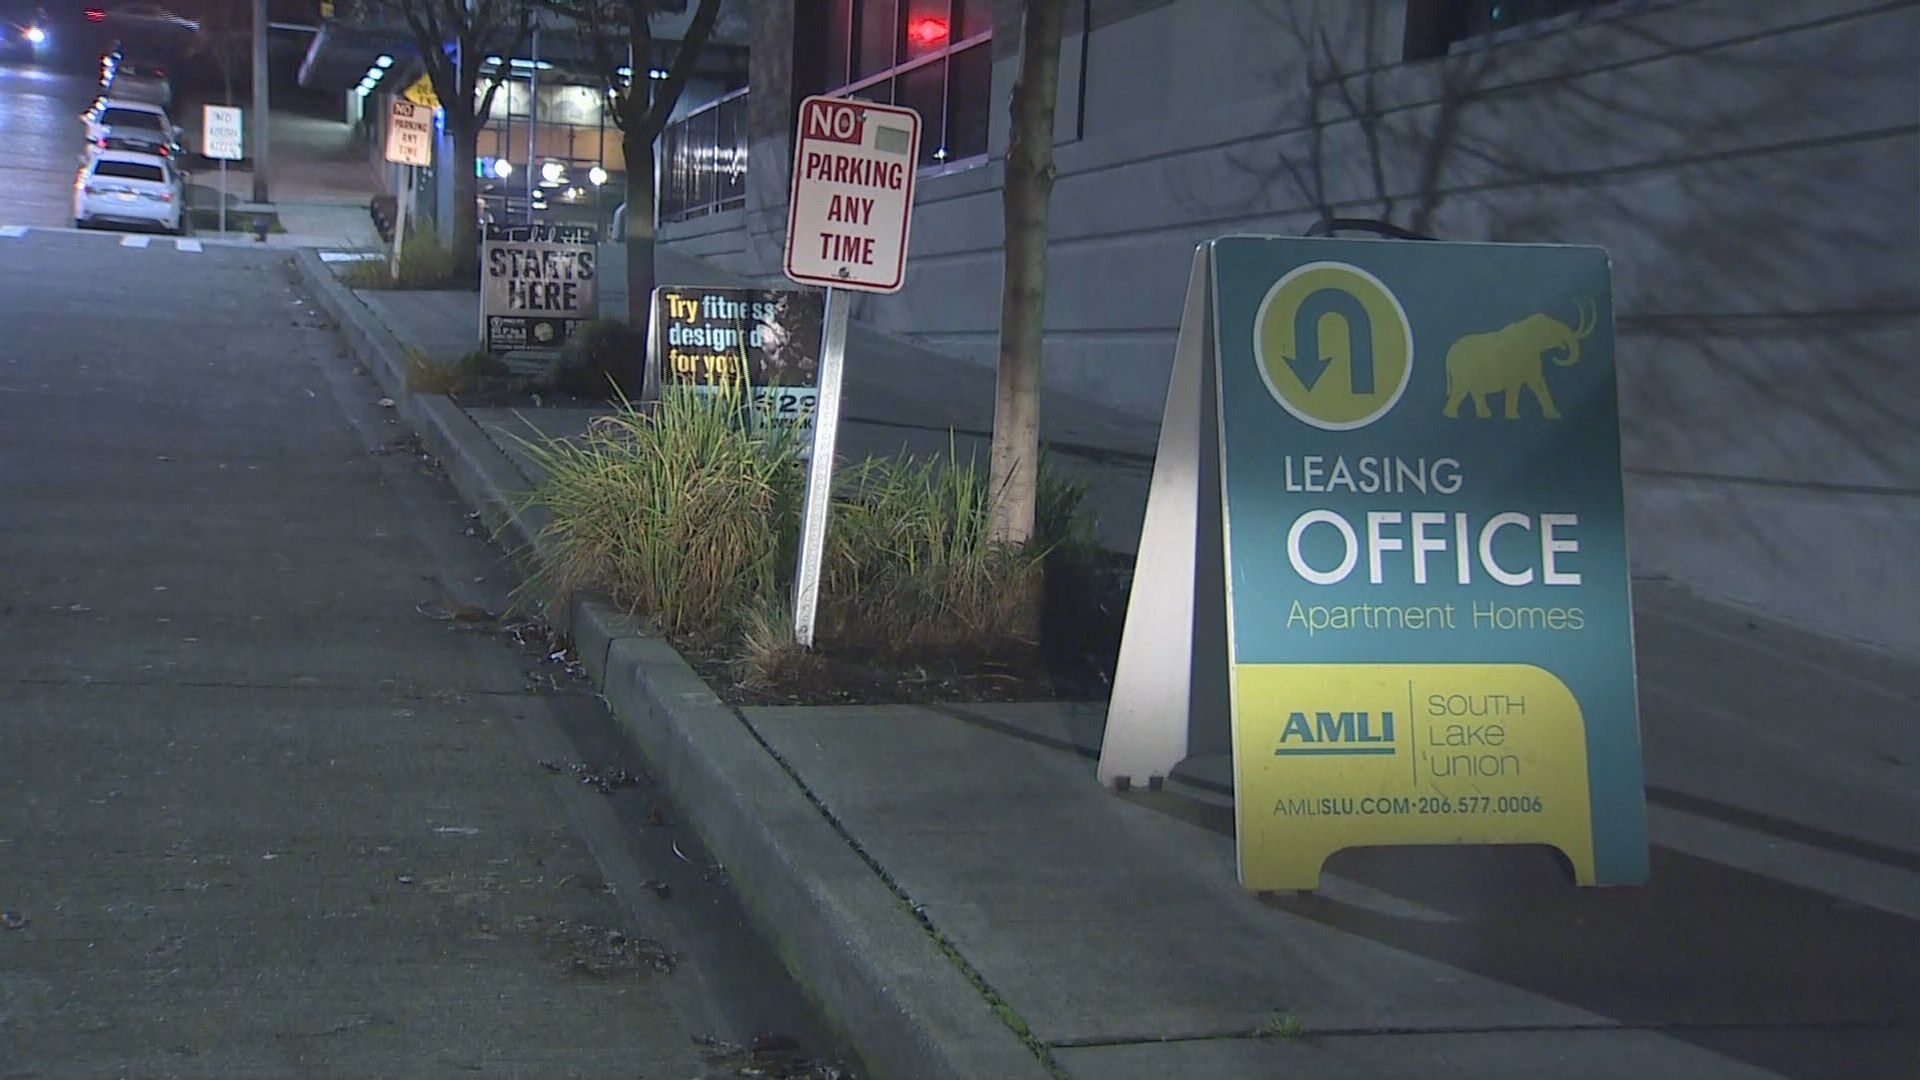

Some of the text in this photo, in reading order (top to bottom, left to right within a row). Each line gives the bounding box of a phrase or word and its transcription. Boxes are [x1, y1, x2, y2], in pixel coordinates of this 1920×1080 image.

[213, 111, 232, 123] NO
[394, 103, 413, 116] NO
[809, 103, 856, 140] NO
[395, 119, 428, 133] PARKING
[402, 132, 418, 144] ANY
[399, 144, 418, 157] TIME
[806, 152, 903, 190] PARKING
[827, 194, 875, 226] ANY
[489, 248, 594, 280] STARTS
[820, 233, 875, 265] TIME
[508, 280, 578, 311] HERE
[666, 294, 698, 323] Try
[669, 349, 699, 373] for
[1284, 455, 1463, 494] LEASING
[1286, 509, 1582, 586] OFFICE
[1285, 600, 1584, 636] Apartment Homes
[1428, 694, 1526, 716] SOUTH
[1279, 711, 1395, 743] AMLI
[1429, 724, 1506, 746] Lake
[1430, 755, 1520, 777] union
